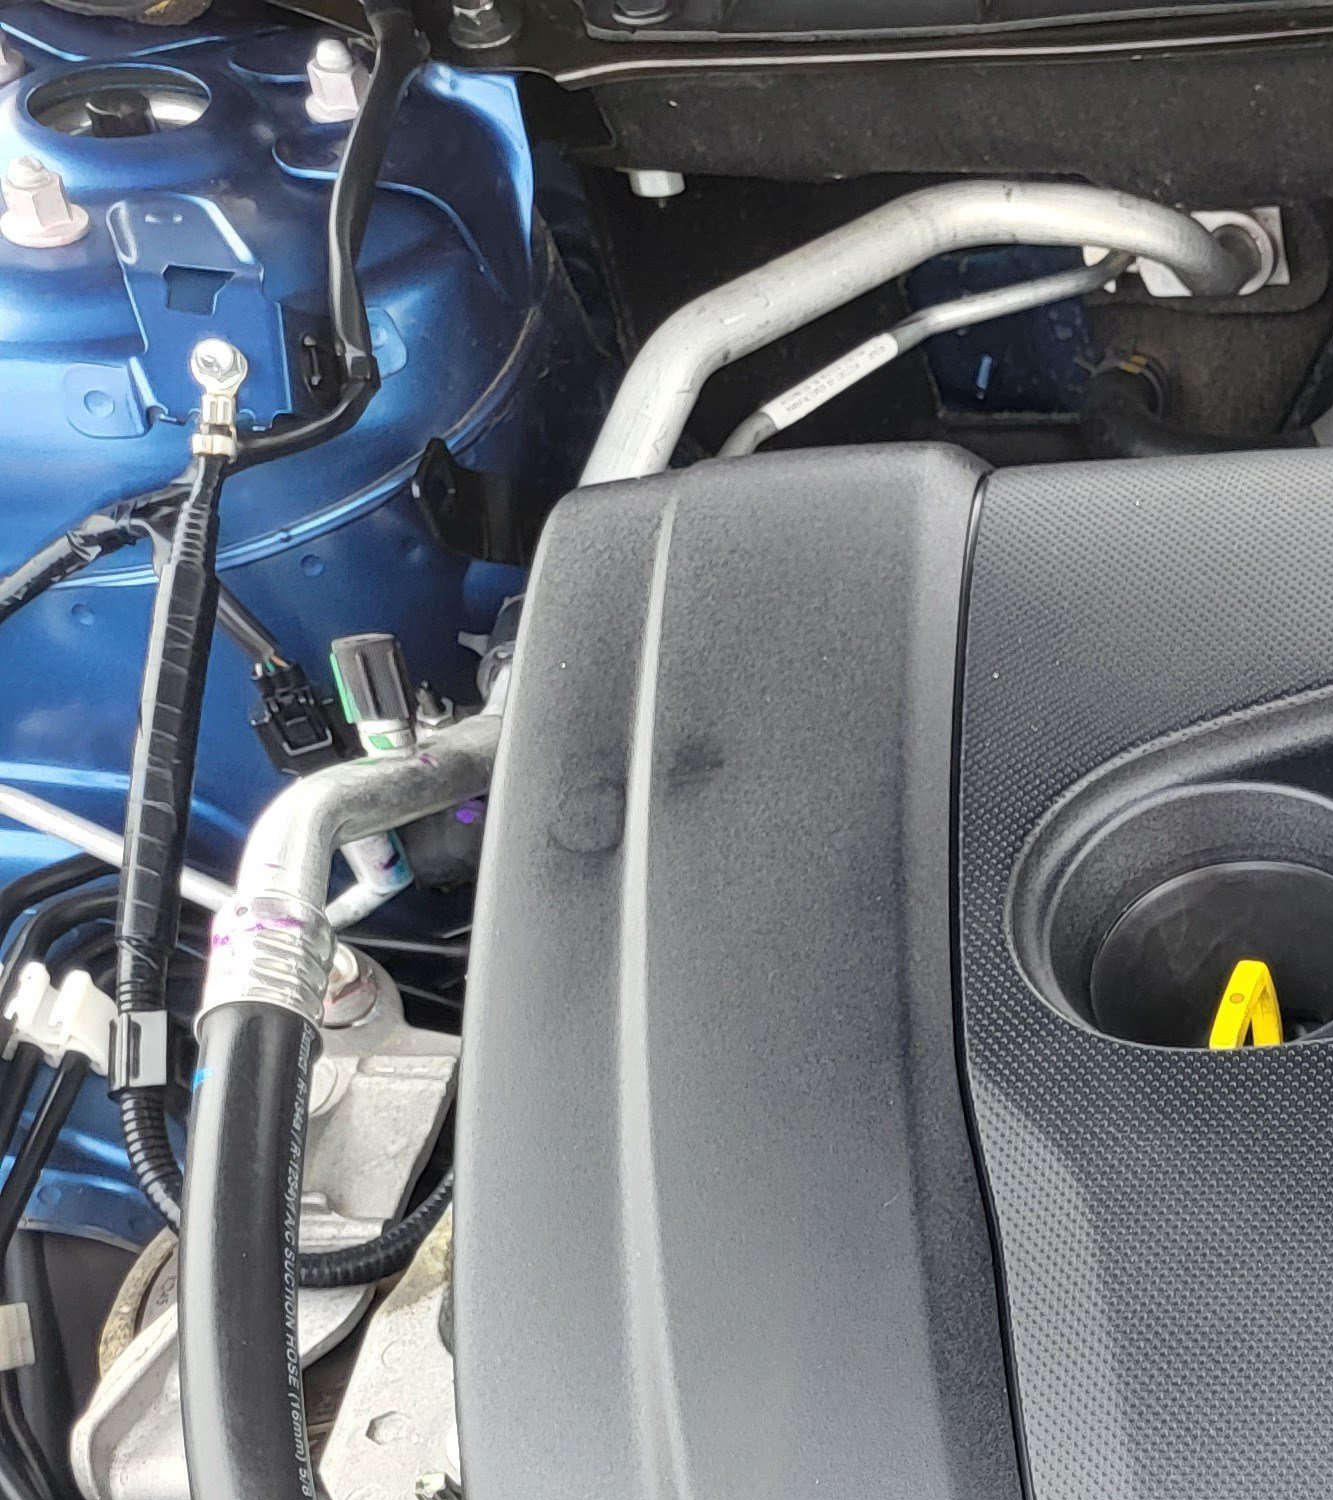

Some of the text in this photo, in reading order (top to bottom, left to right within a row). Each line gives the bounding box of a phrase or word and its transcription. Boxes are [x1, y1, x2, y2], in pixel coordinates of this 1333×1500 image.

[283, 1247, 296, 1333] SUCTION
[285, 1333, 300, 1390] HOSE
[287, 1392, 308, 1463] (16mm)
[298, 1466, 314, 1498] 5/8
